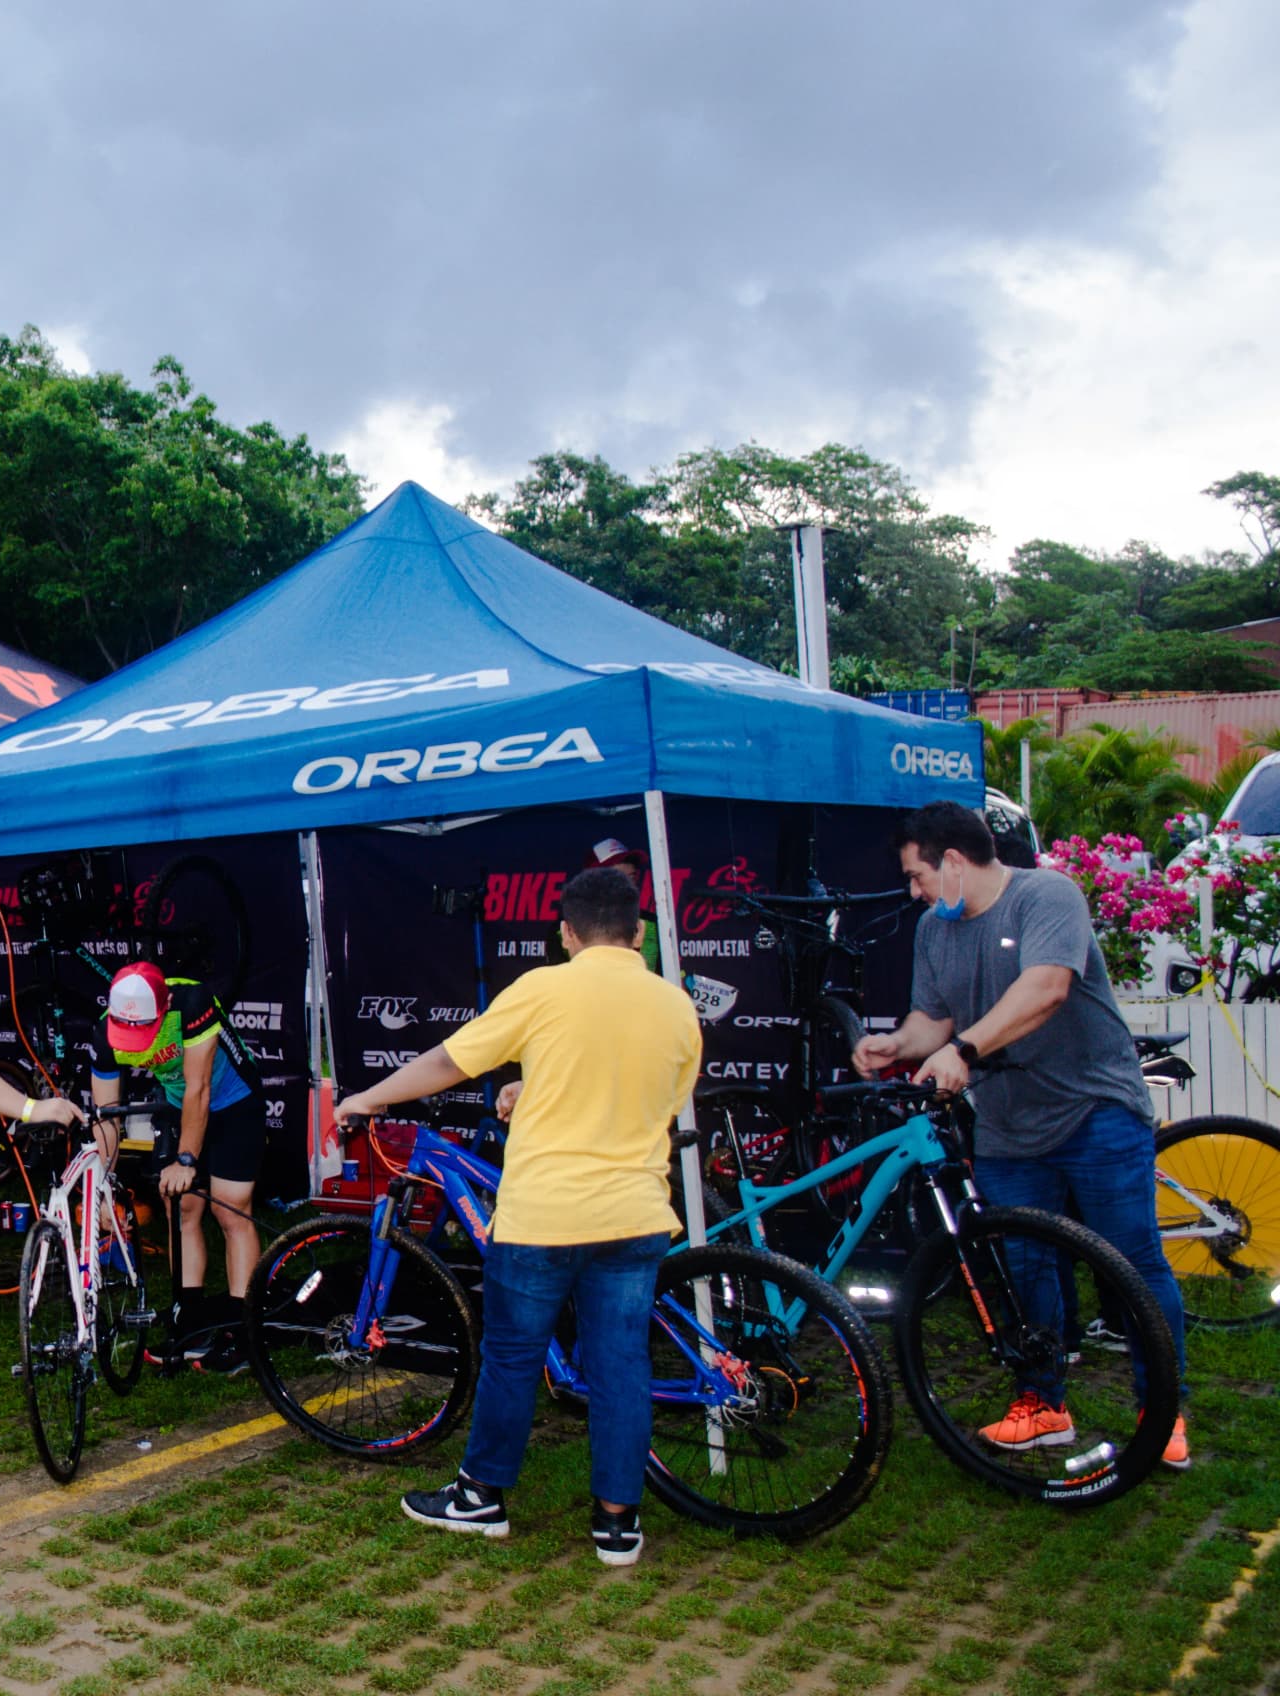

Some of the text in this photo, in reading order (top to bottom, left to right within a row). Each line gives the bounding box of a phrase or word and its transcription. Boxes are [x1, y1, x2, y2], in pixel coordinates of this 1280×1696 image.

[292, 727, 605, 796] ORBEA
[890, 742, 978, 783] ORBEA
[484, 872, 567, 921] BIKE
[680, 939, 750, 957] COMPLETA!
[357, 996, 419, 1030] FOX
[427, 1007, 482, 1022] SPECIA
[706, 1061, 790, 1080] CATEY
